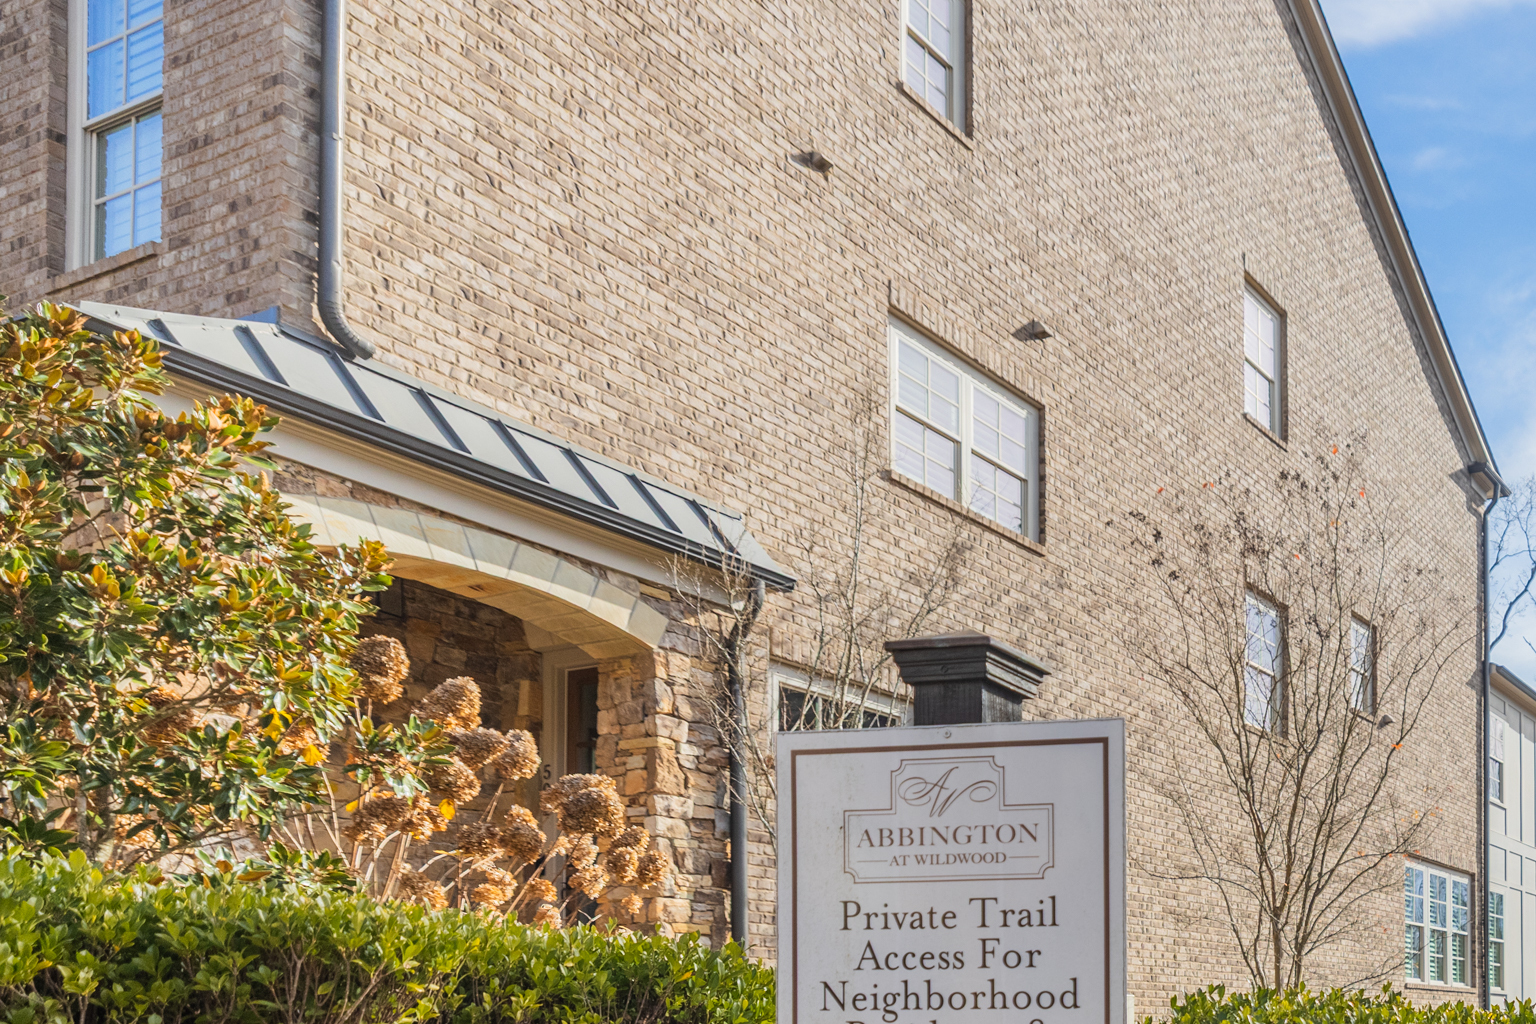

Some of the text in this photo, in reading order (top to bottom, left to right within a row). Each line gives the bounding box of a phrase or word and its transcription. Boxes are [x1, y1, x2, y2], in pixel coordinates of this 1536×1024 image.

[857, 823, 1040, 848] ABBINGTON
[889, 852, 1007, 867] AT WILDWOOD
[839, 896, 1060, 931] Private Trail
[853, 938, 1042, 971] Access For
[820, 978, 1081, 1023] Neighborhood
